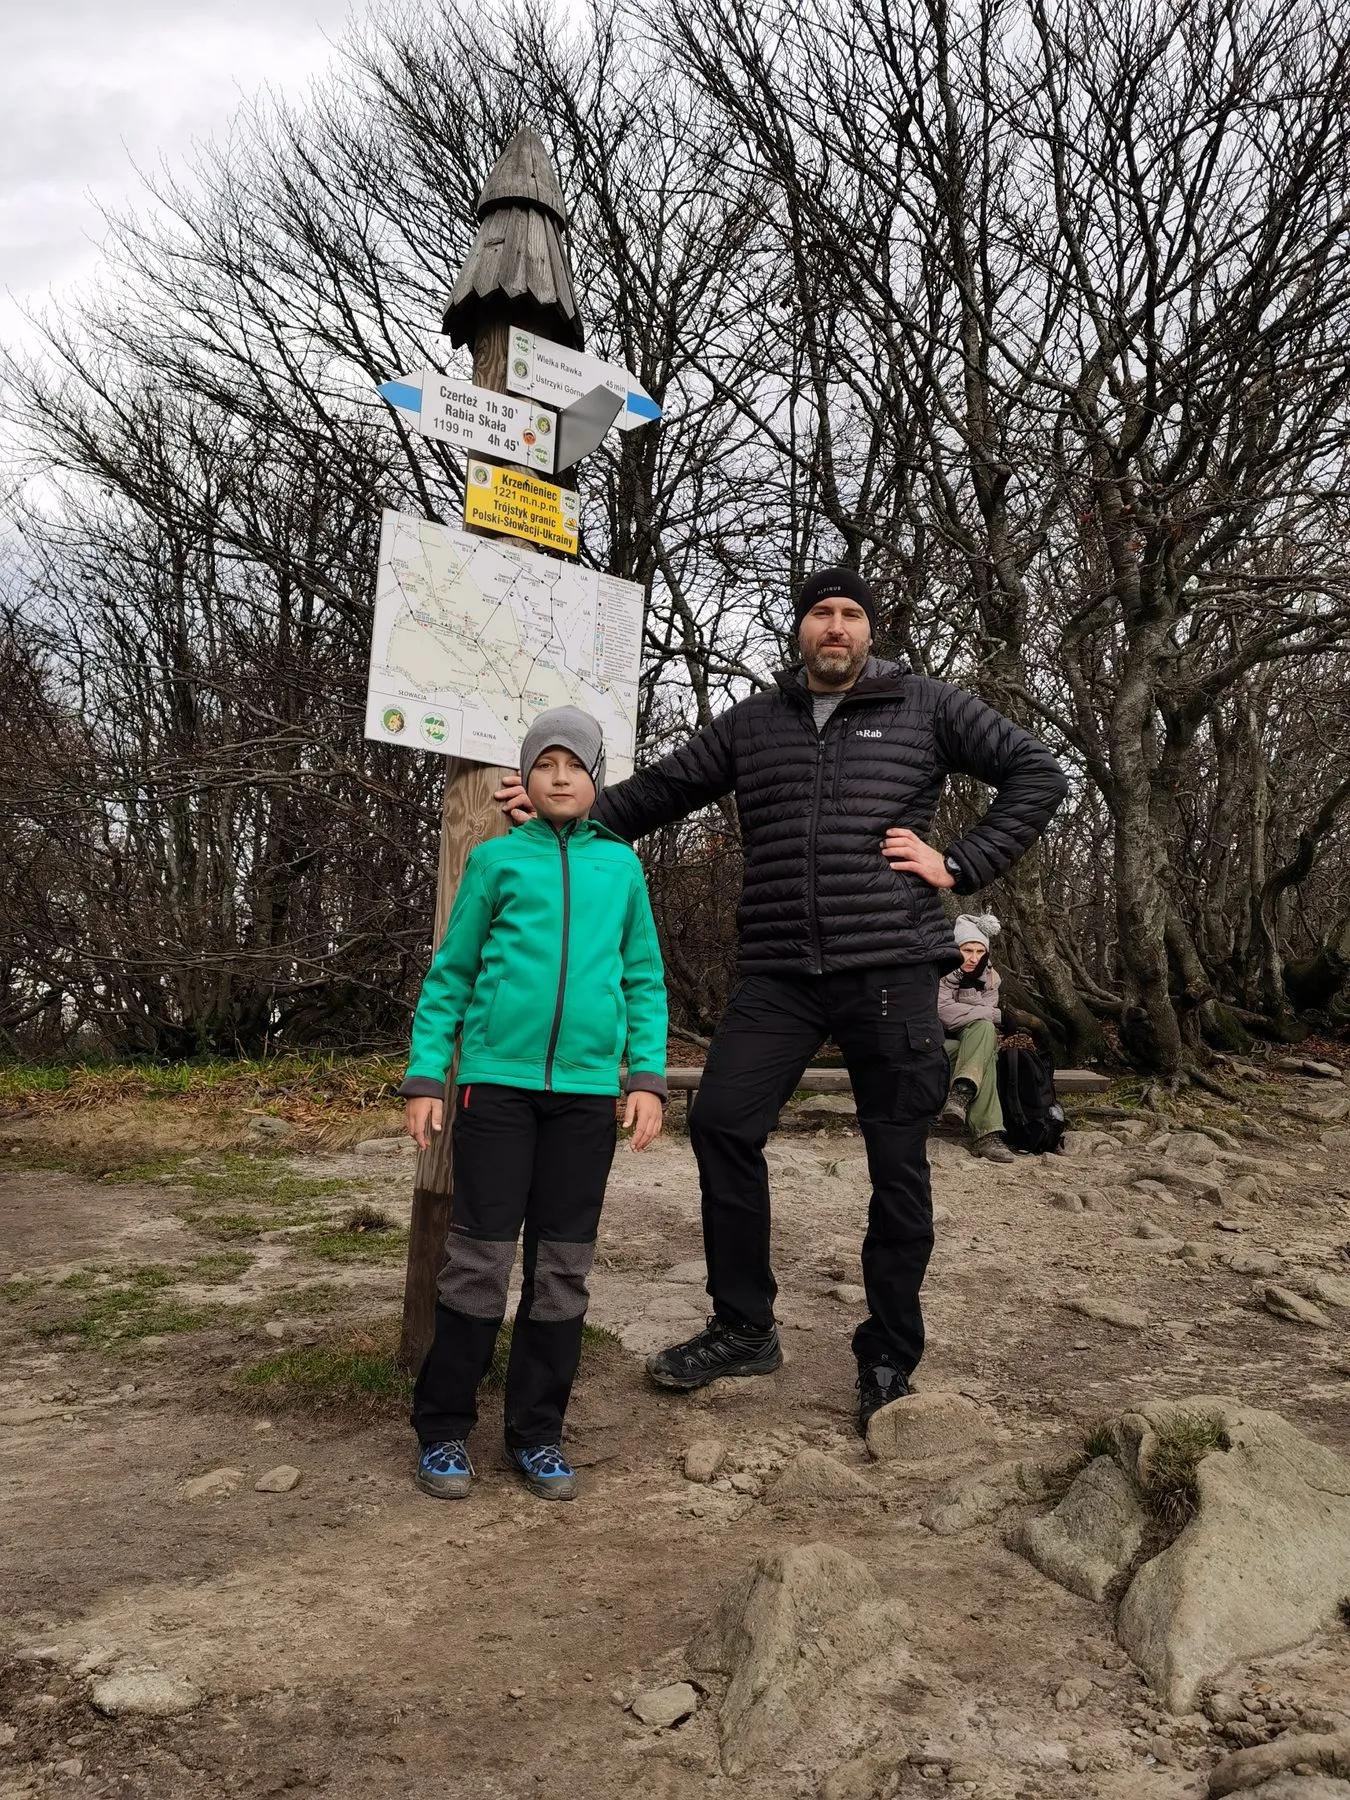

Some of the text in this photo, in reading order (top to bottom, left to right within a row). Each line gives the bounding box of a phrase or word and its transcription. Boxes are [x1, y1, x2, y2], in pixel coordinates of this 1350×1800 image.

[536, 352, 583, 377] Wielka Rawka
[535, 373, 563, 391] Ustrzyki
[605, 379, 626, 393] 45 min
[440, 385, 478, 408] Czerteż
[486, 400, 498, 415] 1h
[433, 417, 460, 434] 1199
[462, 427, 474, 439] m
[487, 433, 501, 447] 4h
[445, 404, 507, 433] Rabia Skała
[493, 486, 517, 500] 1221
[501, 473, 558, 502] Krzemieniec
[493, 499, 557, 528] Trójstyk granic
[472, 507, 573, 549] Polski-Słowacji-Ukrainy
[472, 730, 497, 740] UKRAINA
[863, 729, 882, 738] Rab
